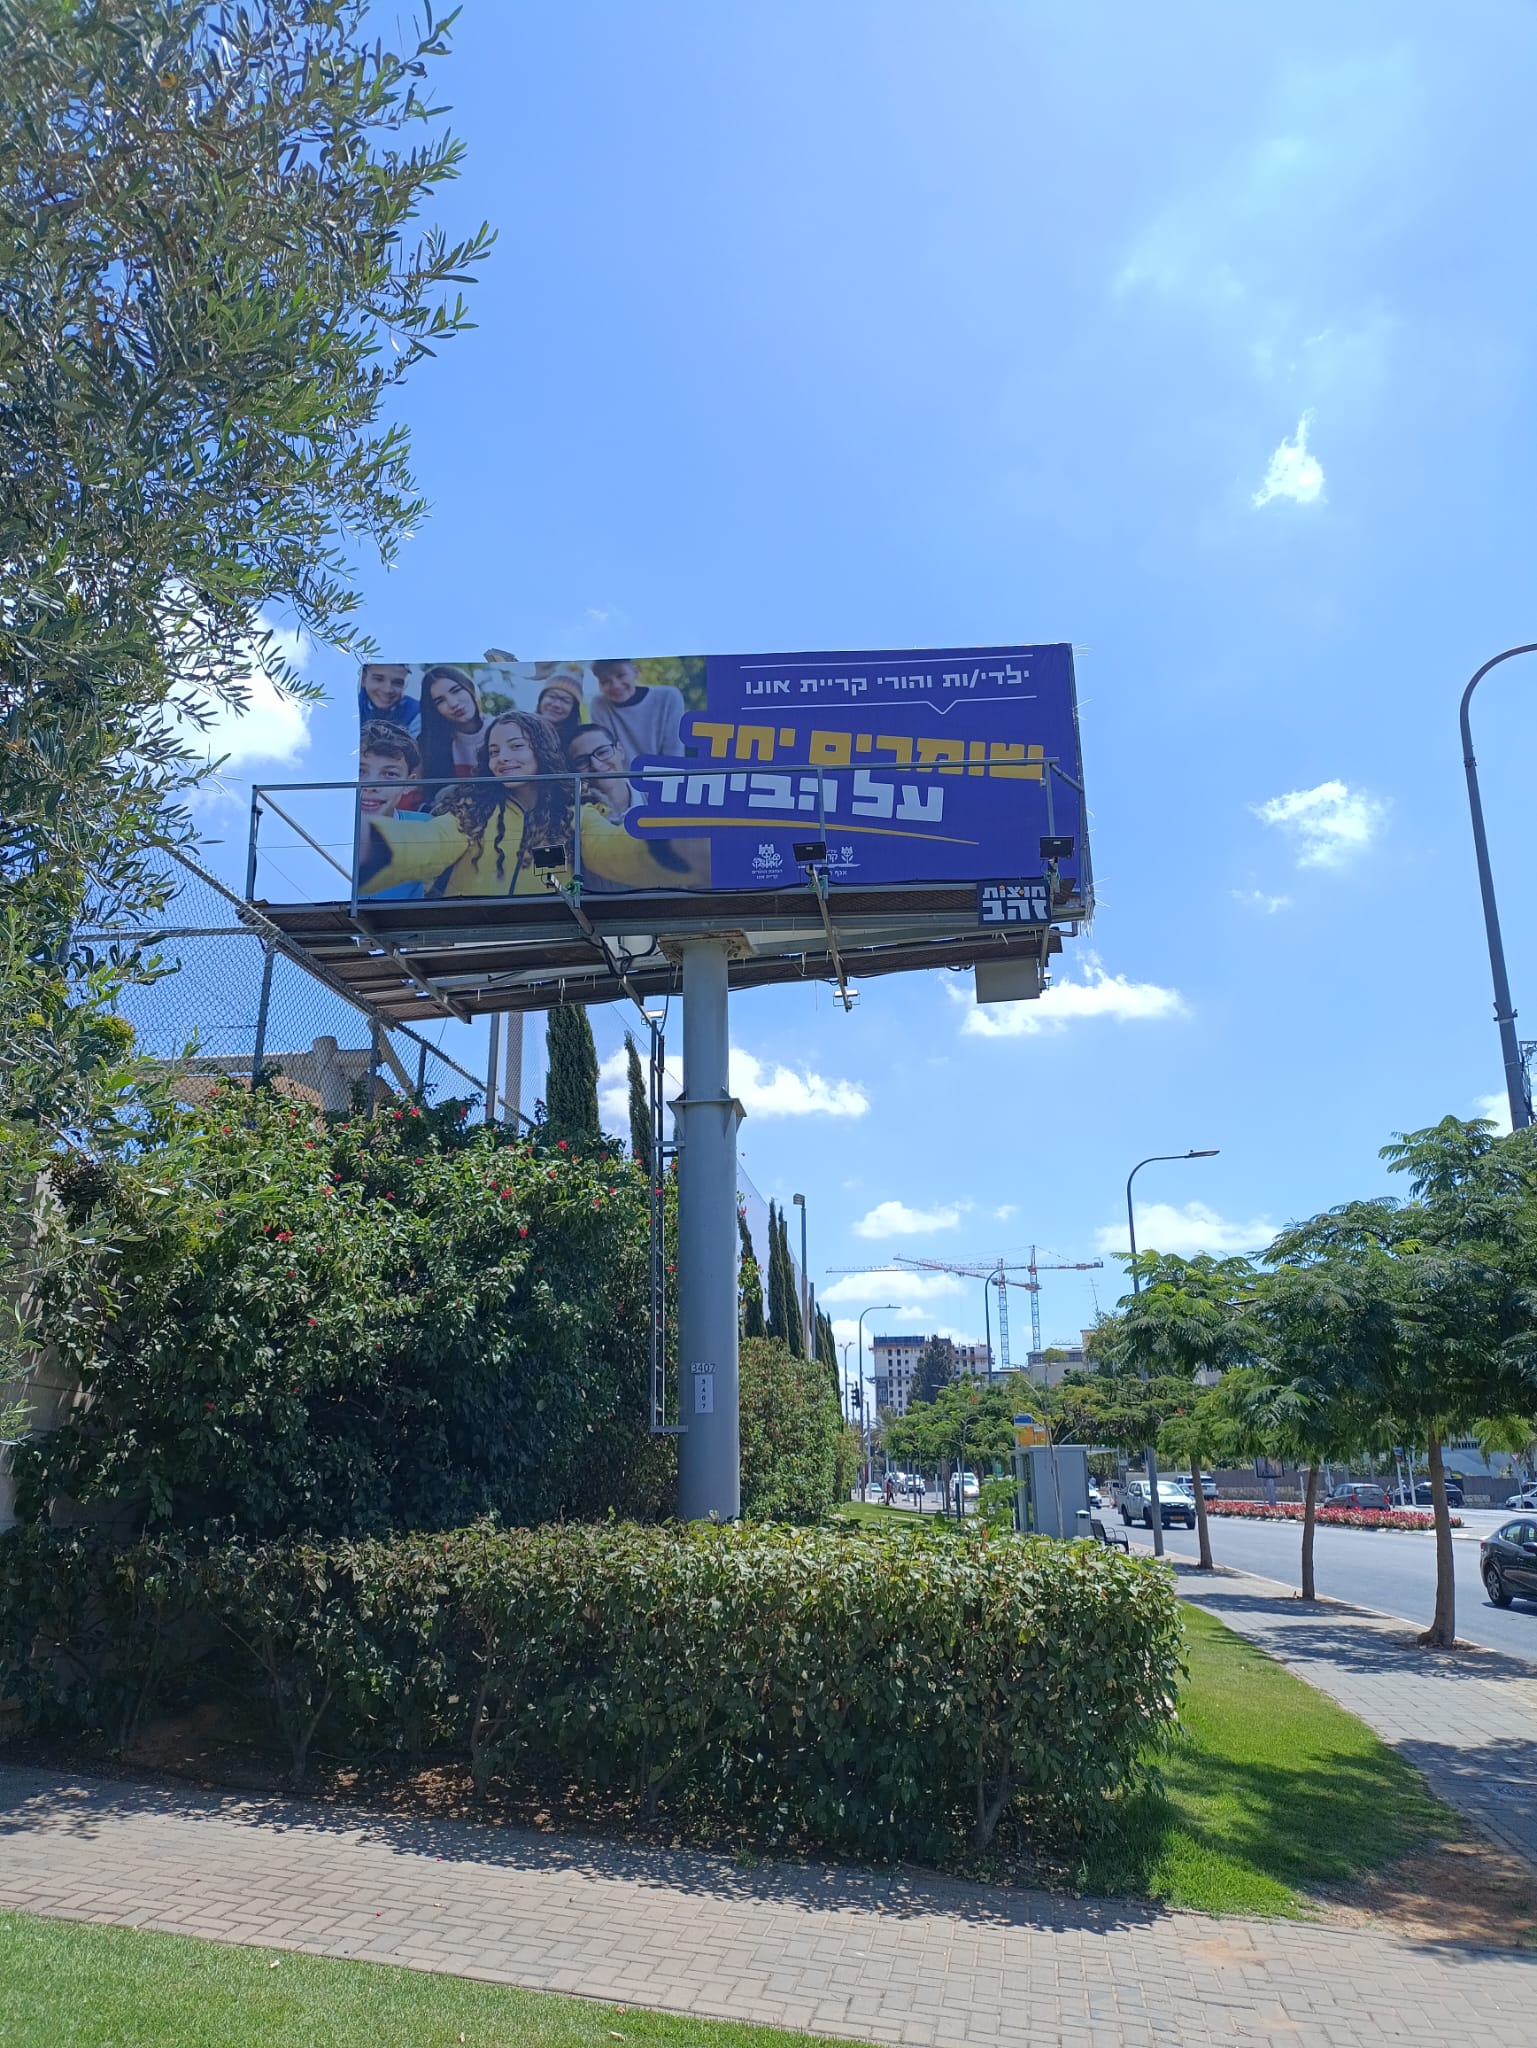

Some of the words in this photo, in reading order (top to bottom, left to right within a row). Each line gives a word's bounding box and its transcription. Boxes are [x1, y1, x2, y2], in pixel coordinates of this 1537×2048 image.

[800, 676, 868, 697] קריית
[877, 674, 933, 690] והורי
[943, 663, 1030, 689] ילדי/ות
[745, 679, 791, 695] אונו
[691, 721, 796, 762] יחד
[808, 730, 1044, 780] שומרים
[642, 766, 838, 813] הביחד
[851, 769, 944, 823] על
[983, 885, 1046, 898] חוצות
[983, 900, 1047, 920] זהב
[691, 1363, 716, 1373] 3407
